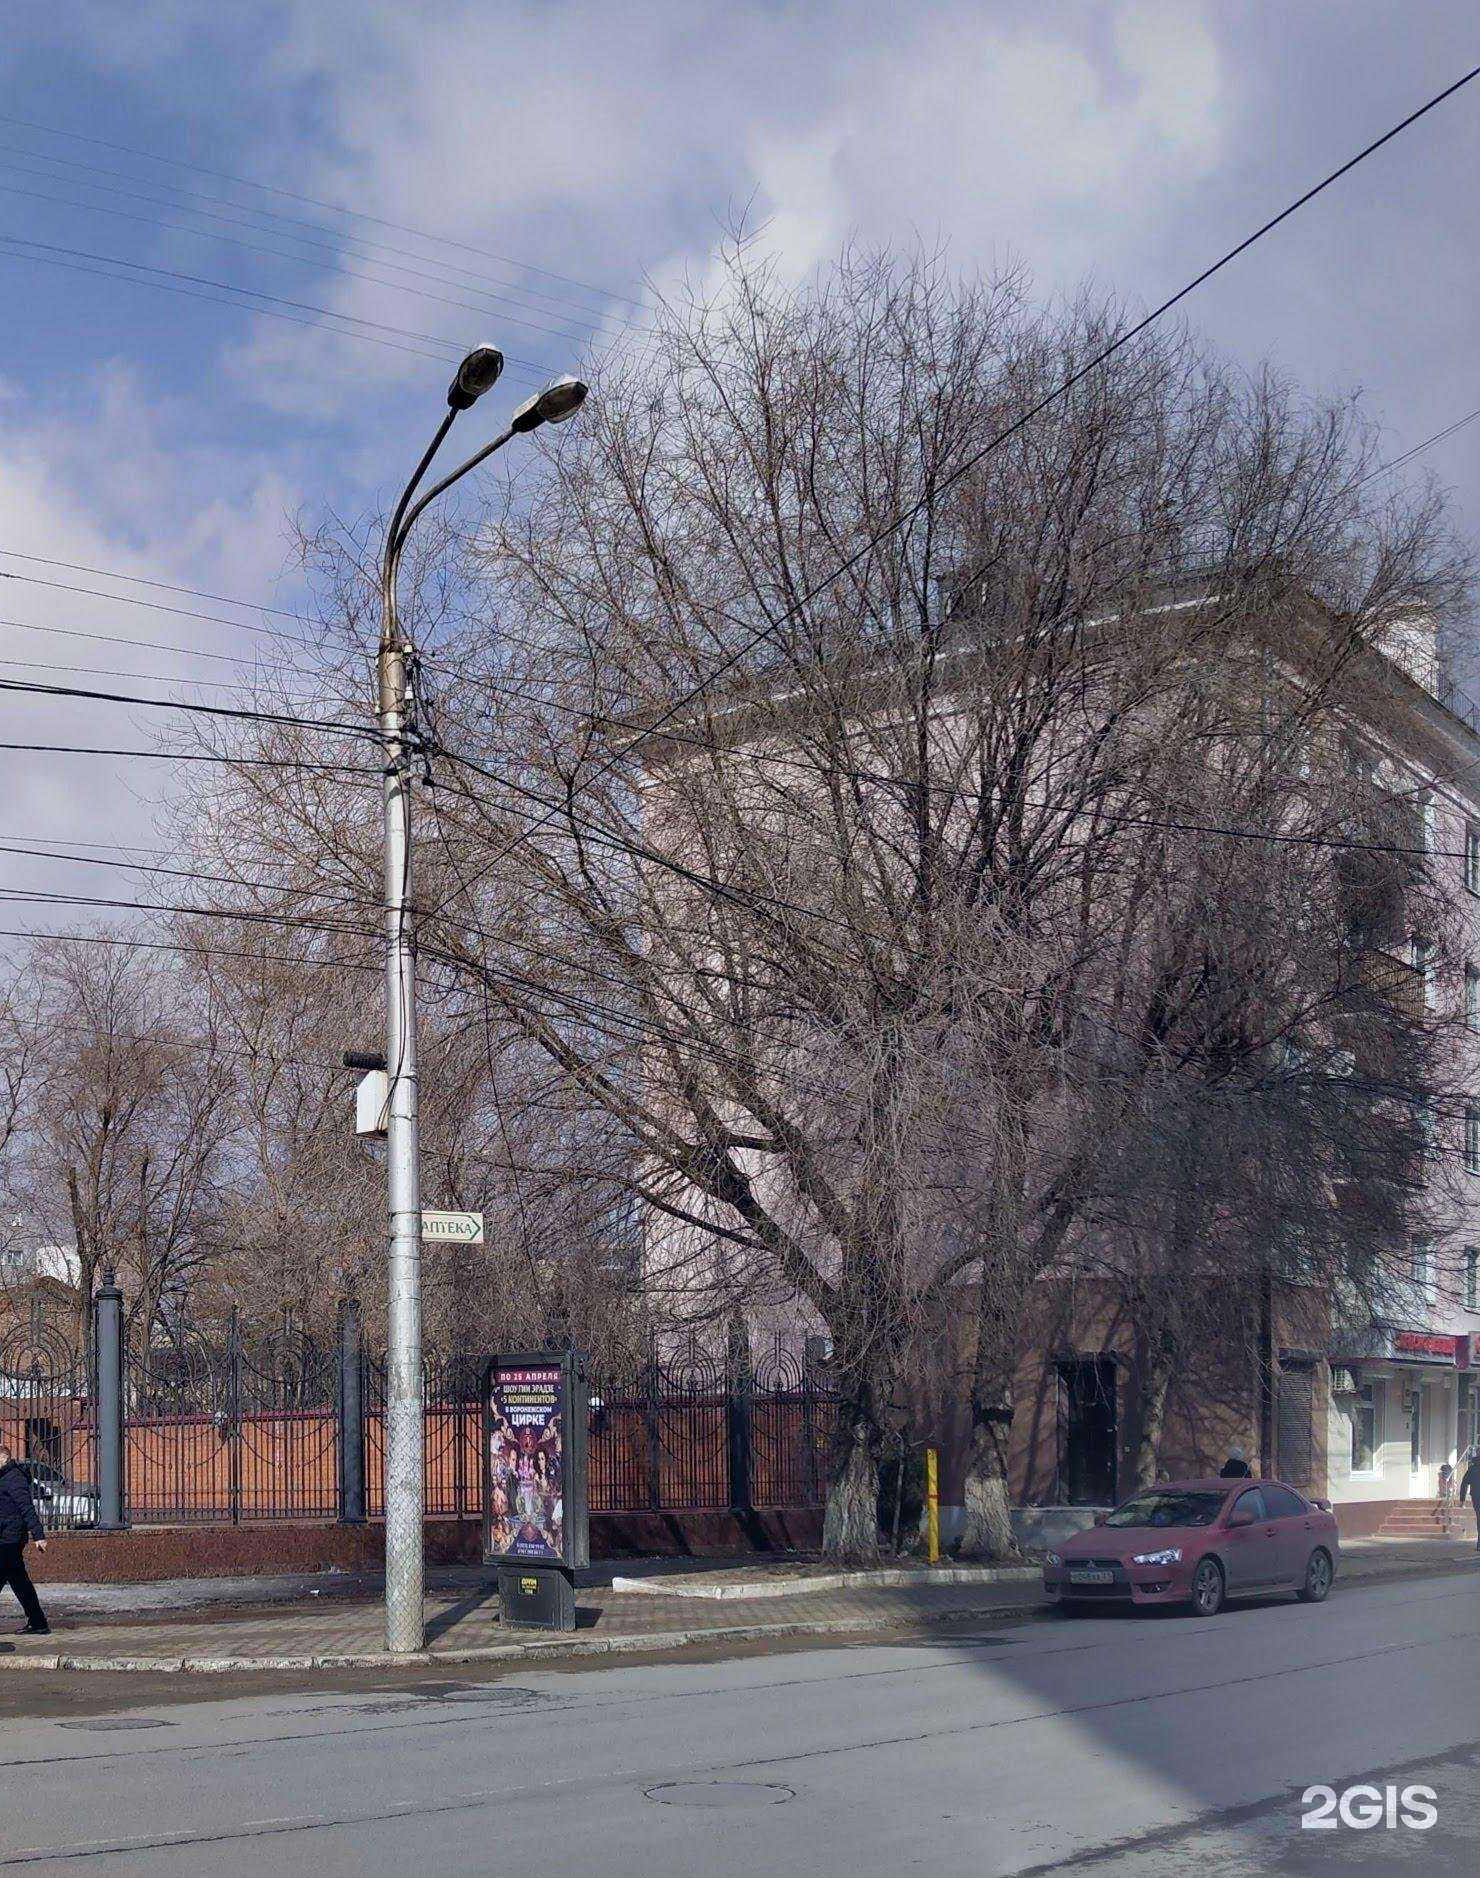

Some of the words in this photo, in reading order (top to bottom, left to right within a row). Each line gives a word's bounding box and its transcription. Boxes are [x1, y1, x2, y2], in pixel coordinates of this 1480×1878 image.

[500, 1373, 511, 1381] ПО
[525, 1372, 559, 1381] АПРЕЛЯ
[511, 1413, 546, 1427] ЦИРКЕ
